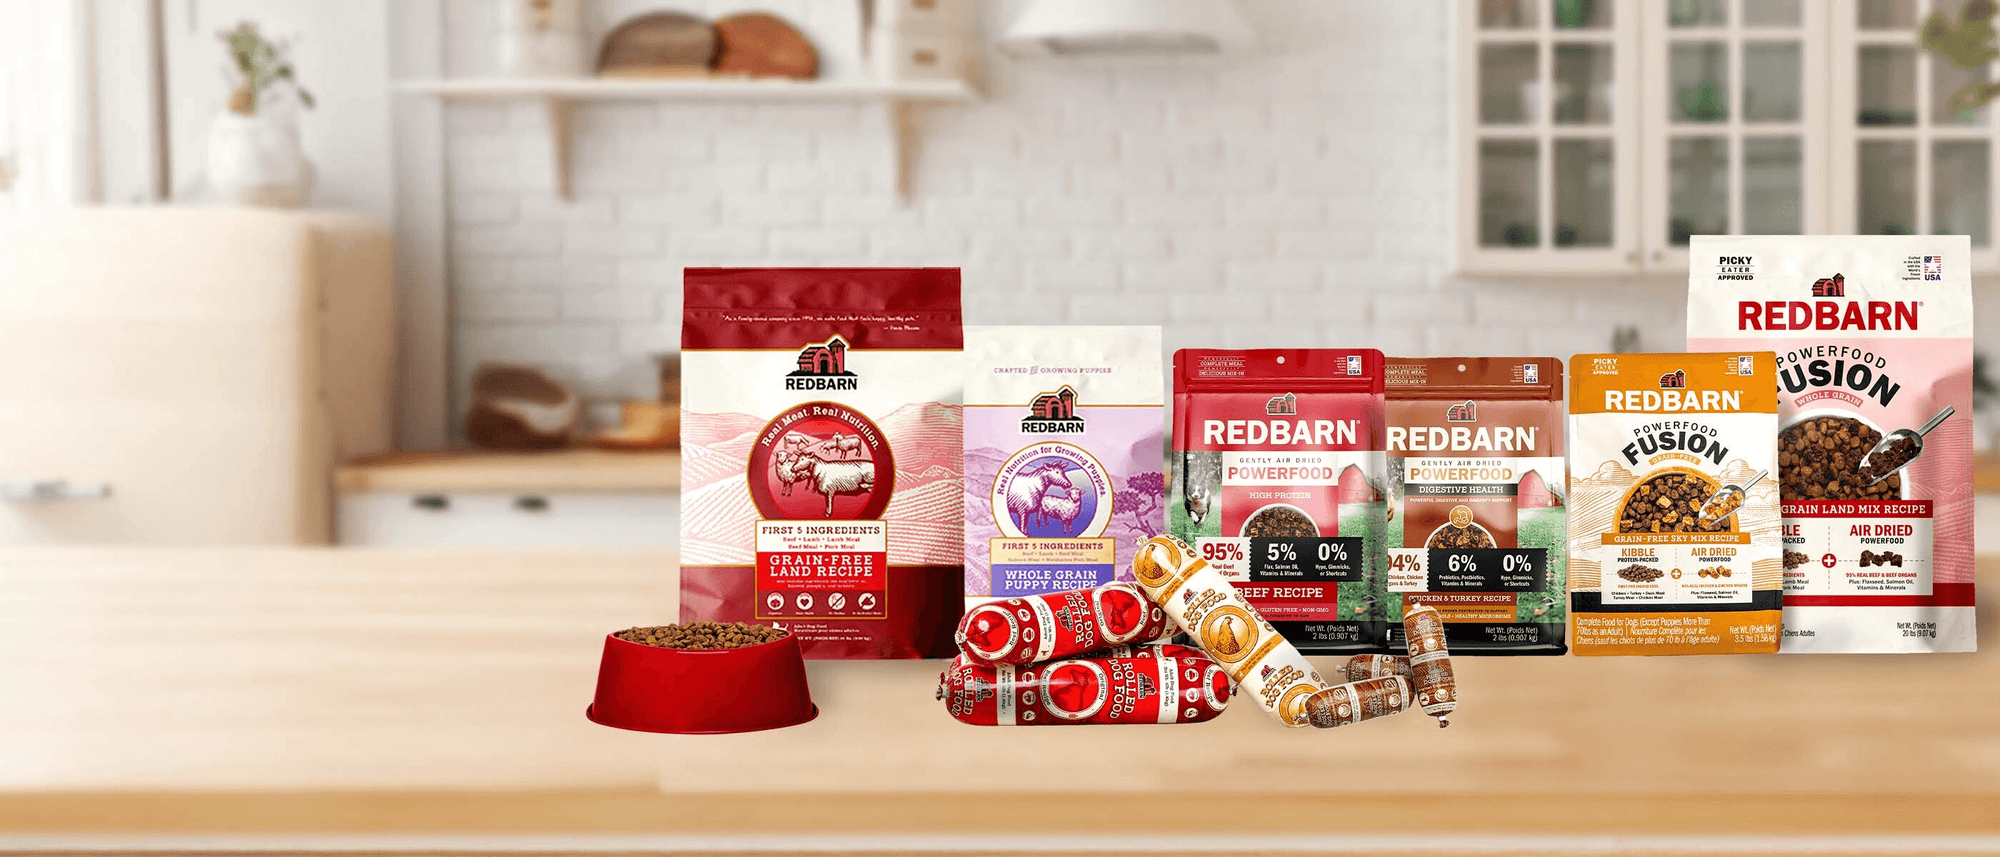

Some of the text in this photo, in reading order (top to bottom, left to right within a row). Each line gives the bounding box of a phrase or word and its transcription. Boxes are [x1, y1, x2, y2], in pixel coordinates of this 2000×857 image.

[1719, 256, 1752, 265] PICKY
[1776, 345, 1886, 369] POWERFOOD
[785, 378, 857, 390] REDBARN
[1605, 390, 1741, 411] REDBARN
[1797, 391, 1862, 408] WHOLE GRAIN
[761, 423, 782, 447] Real
[813, 406, 838, 417] Real
[1021, 422, 1084, 433] REDBARN
[1633, 421, 1718, 438] POWERFOOD
[1622, 431, 1729, 466] FUSION
[1652, 454, 1698, 464] GRAIN-FREE
[996, 475, 1009, 495] Real
[1005, 449, 1039, 475] Nutrition
[1040, 446, 1052, 454] for
[1055, 446, 1089, 466] Growing
[1228, 467, 1332, 480] POWERFOOD
[1410, 468, 1512, 480] POWERFOOD
[1418, 486, 1504, 494] DIGESTIVE HEALTH
[1781, 505, 1926, 514] GRAIN LAND MIX RECIPE
[762, 527, 880, 535] FIRST 5 INGREDIENTS
[1850, 525, 1913, 536] AIR DRIED
[1614, 534, 1740, 543] GRAIN-FREE SKY MIX RECIPE
[1202, 543, 1244, 560] 95%
[1267, 543, 1296, 560] 5%
[1318, 543, 1348, 560] 0%
[1622, 548, 1655, 556] KIBBLE
[1691, 548, 1737, 556] AIR DRIED
[769, 555, 873, 566] GRAIN-FREE
[1448, 554, 1476, 572] 6%
[1502, 554, 1532, 572] 0%
[770, 566, 873, 577] LAND RECIPE
[1005, 570, 1097, 580] WHOLE GRAIN
[1005, 580, 1098, 590] PUPPY RECIPE
[1273, 588, 1324, 598] RECIPE
[1183, 588, 1216, 622] ROLLED
[1188, 611, 1202, 632] DOG
[1200, 592, 1227, 614] FOOD
[1065, 594, 1084, 644] ROLLED
[1577, 617, 1710, 627] Complete Food for Dogs (Except Puppies More Than
[1084, 620, 1094, 648] DOG
[1730, 625, 1776, 634] Net Wt. (Poids Net)
[1902, 630, 1908, 638] 20
[1917, 630, 1928, 638] (9.07
[1492, 634, 1538, 642] 2 lbs (0.907 kg)
[1260, 664, 1294, 698] ROLLED
[1107, 658, 1126, 719] DOG FOOD
[1122, 662, 1136, 714] ROLLED
[1266, 688, 1281, 708] DOG
[1278, 670, 1304, 690] FOOD
